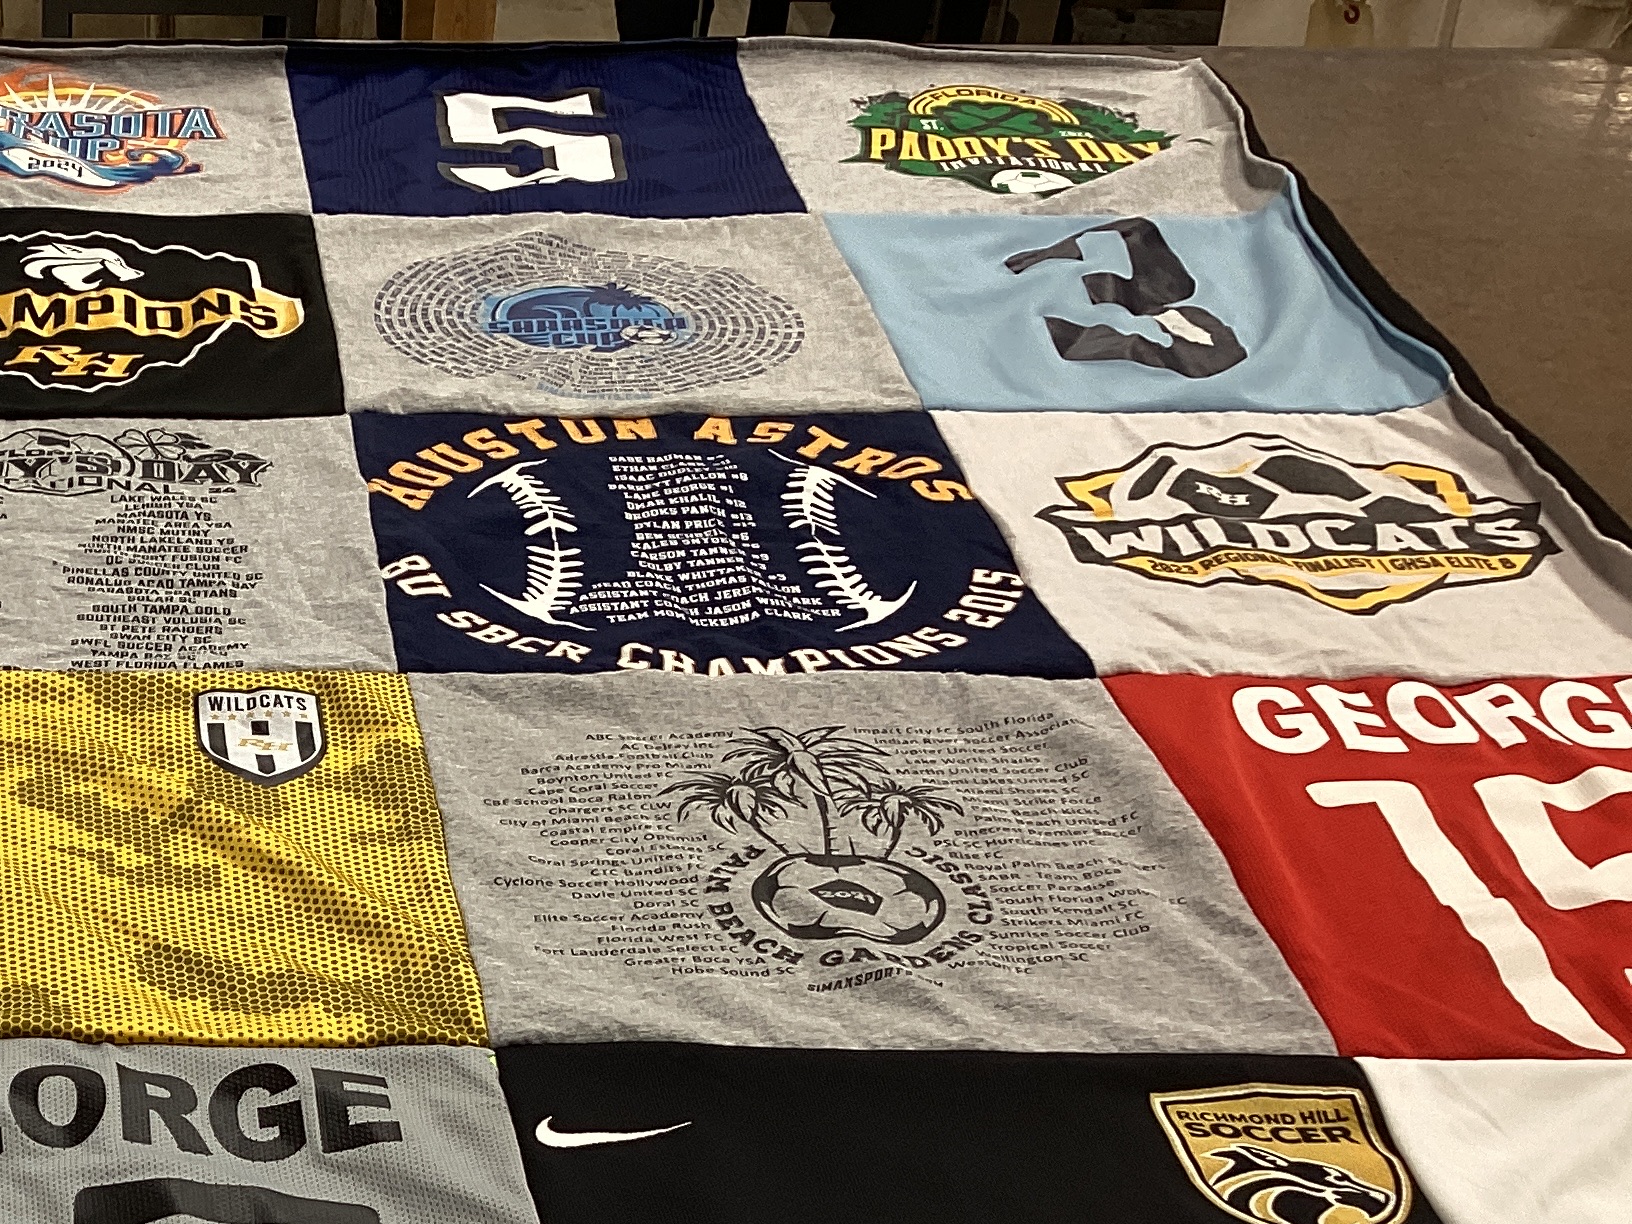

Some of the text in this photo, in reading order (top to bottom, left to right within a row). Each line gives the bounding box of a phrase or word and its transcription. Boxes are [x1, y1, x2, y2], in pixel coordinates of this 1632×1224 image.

[933, 89, 1036, 105] FLORIDA
[919, 119, 944, 131] ST.
[432, 87, 628, 193] 5
[870, 128, 1161, 163] PADDY'S DAY
[28, 157, 83, 177] 2024
[940, 157, 1108, 174] INVITATIONAL
[1004, 217, 1248, 379] 3
[4, 344, 145, 378] RH
[368, 416, 974, 511] HOUSTON ASTROS
[612, 464, 657, 472] ETHAN
[141, 459, 274, 487] DAY
[675, 472, 727, 484] FALLON
[663, 483, 716, 495] GEORGE
[626, 499, 665, 510] OMAR
[116, 510, 189, 520] MANASOTA
[624, 505, 678, 520] BROOKS
[634, 518, 726, 530] DYLAN PRICE
[117, 525, 210, 537] NMSC MUTINY
[92, 535, 212, 545] NORTH LAKELAND
[1071, 517, 1542, 558] WILDCATS
[126, 545, 249, 555] MANATEE SOCCER
[630, 550, 686, 561] CARSON
[171, 554, 223, 562] FUSION
[639, 556, 745, 572] COLBY TANNER
[1150, 559, 1199, 575] 2023
[1199, 552, 1292, 571] REGIONAL
[1293, 557, 1375, 573] FINALIST
[1392, 556, 1444, 571] GHSA
[1448, 556, 1498, 571] ELITE
[62, 566, 241, 581] PINELLAS UNITED
[138, 579, 174, 589] ACAD
[685, 575, 748, 592] THOMAS
[579, 589, 659, 601] ASSISTANT
[92, 604, 189, 615] SOUTH TAMPA
[570, 600, 752, 615] ASSISTANT JASON
[77, 614, 158, 624] SOUTHEAST
[380, 554, 1025, 677] 8U SBCR CHAMPIONS 2015
[606, 608, 813, 627] TEAM MCKENNA CLARK
[121, 625, 223, 635] PETE RAIDERS
[156, 634, 188, 643] CITY
[117, 641, 172, 651] SOCCER
[71, 660, 178, 669] WEST FLORIDA
[208, 694, 307, 711] WILDCATS
[956, 711, 1054, 735] South Florida
[1230, 679, 1632, 755] GEORG
[669, 731, 734, 739] Academy
[1054, 757, 1089, 773] Club
[569, 783, 607, 794] Coral
[548, 801, 672, 816] Chargers CLW
[540, 827, 595, 838] Coastal
[1011, 861, 1051, 869] Palm
[493, 875, 699, 888] Cyclone Hollywood
[571, 891, 615, 900] Davie
[1047, 895, 1104, 904] Florida
[633, 900, 676, 909] Doral
[707, 900, 805, 966] BEACH
[904, 846, 994, 926] CLASSIC
[573, 911, 704, 923] Soccer Academy
[988, 924, 1150, 940] Sunrise Soccer Club
[570, 946, 661, 957] Lauderdale
[624, 956, 766, 967] Greater YSA
[720, 966, 796, 977] Sound SC
[1176, 1108, 1349, 1125] RICHMOND HILL
[1184, 1122, 1360, 1144] SOCCER
